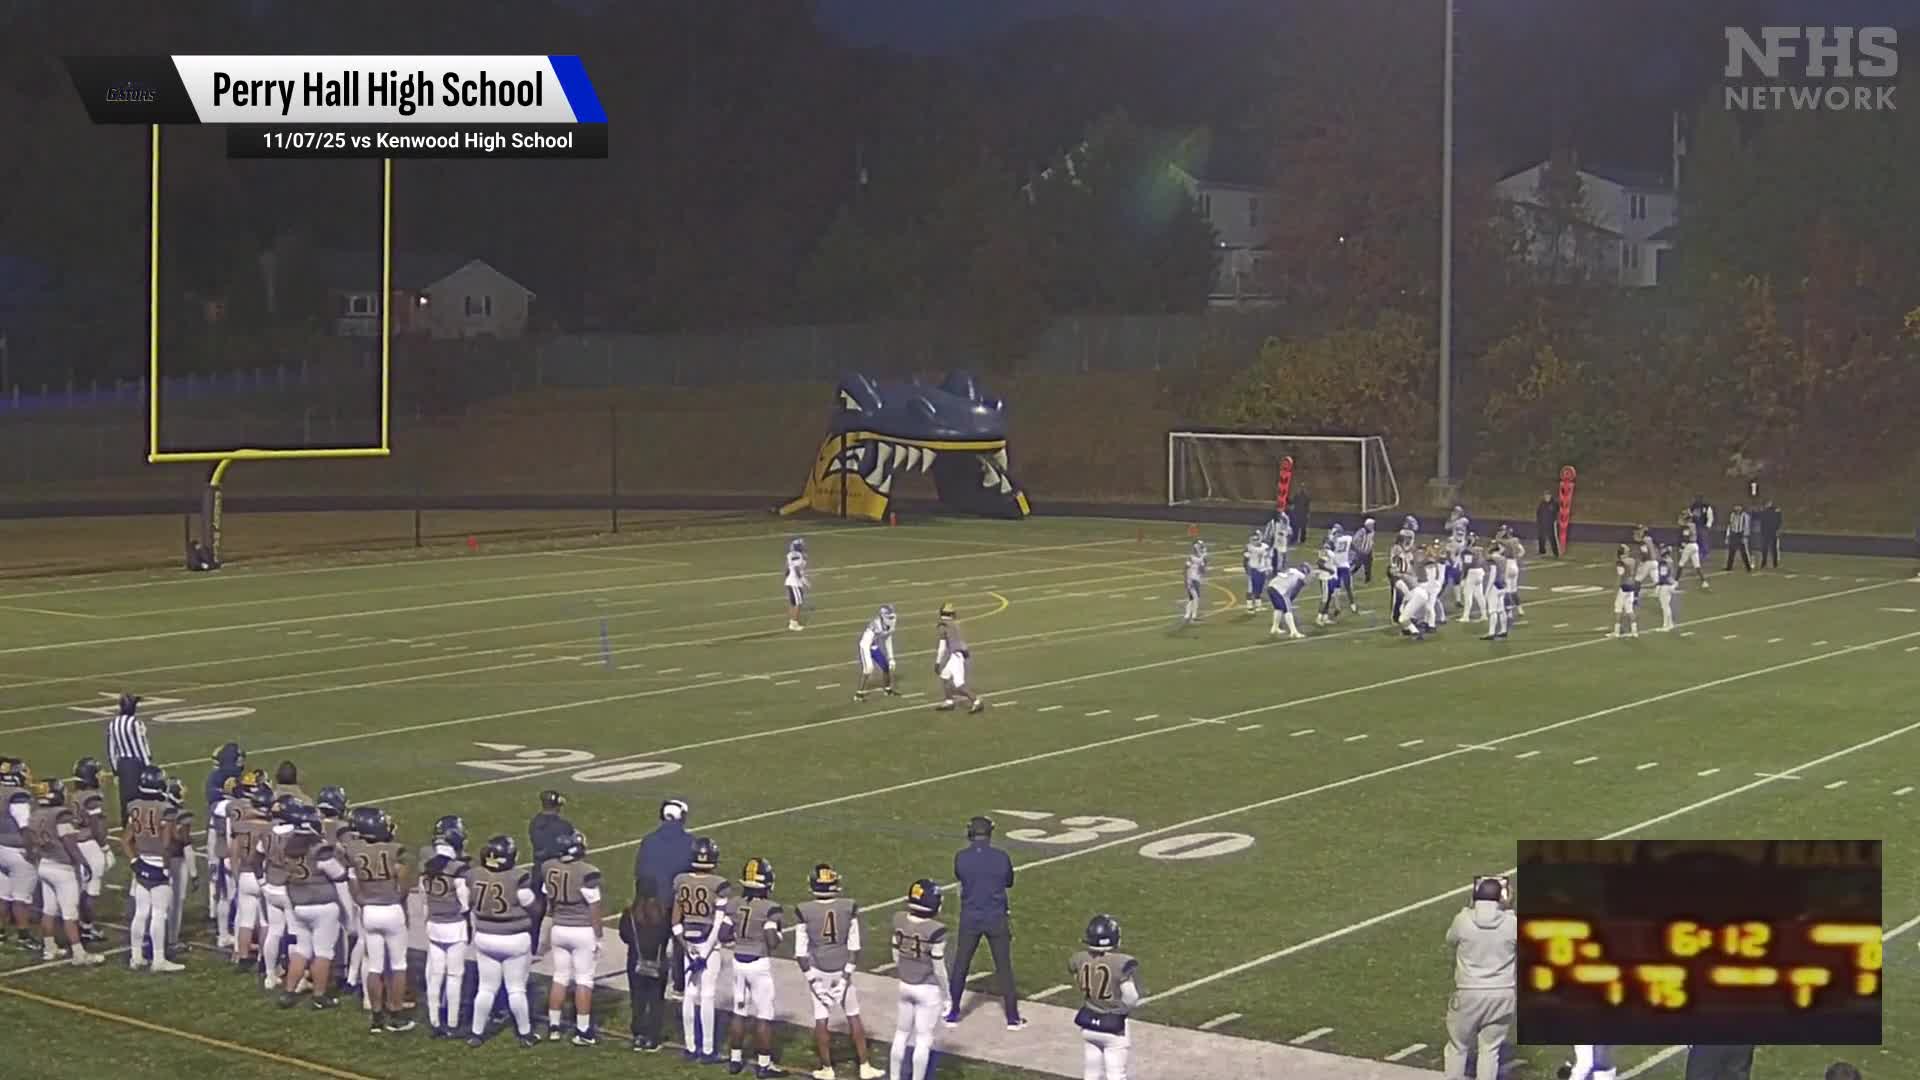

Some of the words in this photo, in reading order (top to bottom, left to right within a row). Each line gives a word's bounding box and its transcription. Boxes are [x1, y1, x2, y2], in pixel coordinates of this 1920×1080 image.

[475, 882, 509, 914] 73
[546, 869, 570, 905] 51
[678, 884, 710, 918] 88
[738, 905, 751, 939] 7
[821, 910, 838, 945] 4
[1669, 920, 1771, 957] 6:12
[1079, 963, 1114, 1001] 42
